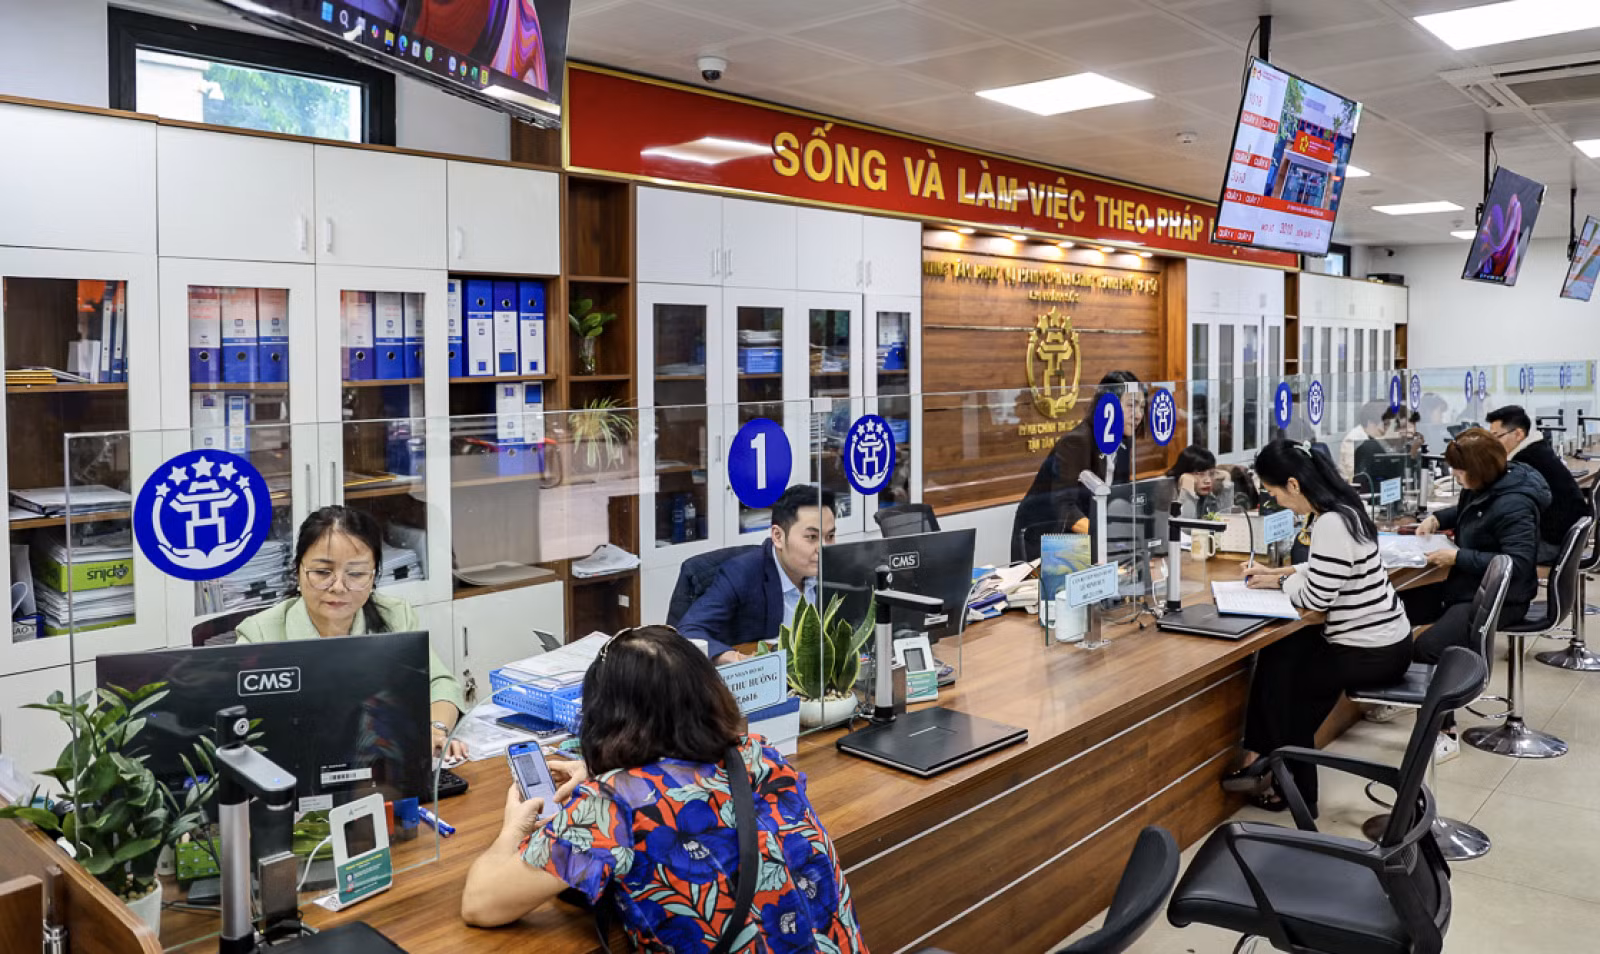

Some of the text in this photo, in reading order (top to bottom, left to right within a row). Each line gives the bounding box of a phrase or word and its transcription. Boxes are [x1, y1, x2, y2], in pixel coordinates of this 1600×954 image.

[772, 122, 888, 191] SỐNG
[904, 149, 945, 200] VÀ
[957, 160, 1018, 213] LÀM
[1028, 177, 1086, 228] VIỆC
[1094, 195, 1150, 234] THEO
[1156, 205, 1204, 241] PHÁP
[1280, 389, 1288, 422] 3
[1103, 402, 1115, 443] 2
[750, 432, 767, 489] 1
[892, 554, 916, 568] CMS
[243, 671, 293, 692] CMS
[731, 680, 746, 692] THU
